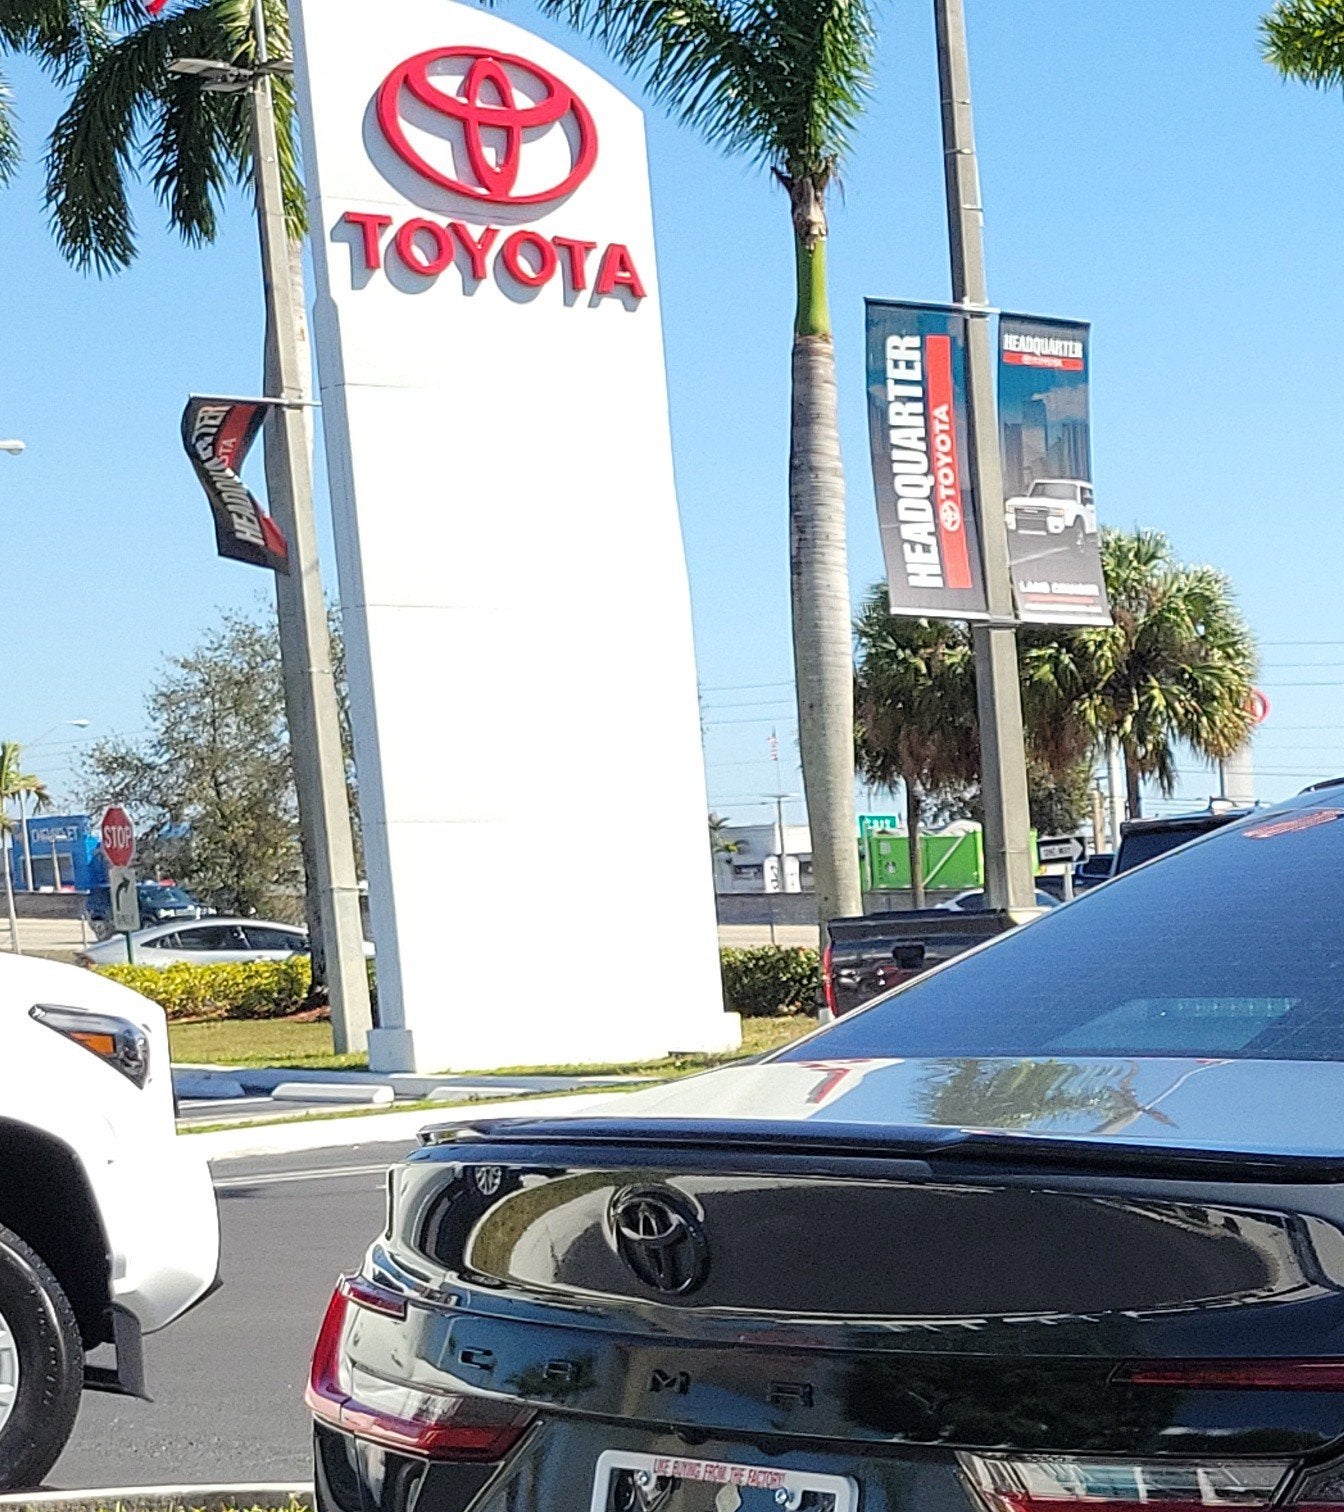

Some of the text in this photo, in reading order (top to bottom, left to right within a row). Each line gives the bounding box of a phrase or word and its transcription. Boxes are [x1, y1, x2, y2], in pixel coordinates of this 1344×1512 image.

[345, 211, 648, 299] TOYOTA
[1003, 334, 1083, 358] HEADQUARTER
[885, 334, 945, 588] HEADQUARTER
[931, 403, 957, 502] TOYOTA
[103, 825, 133, 848] STOP
